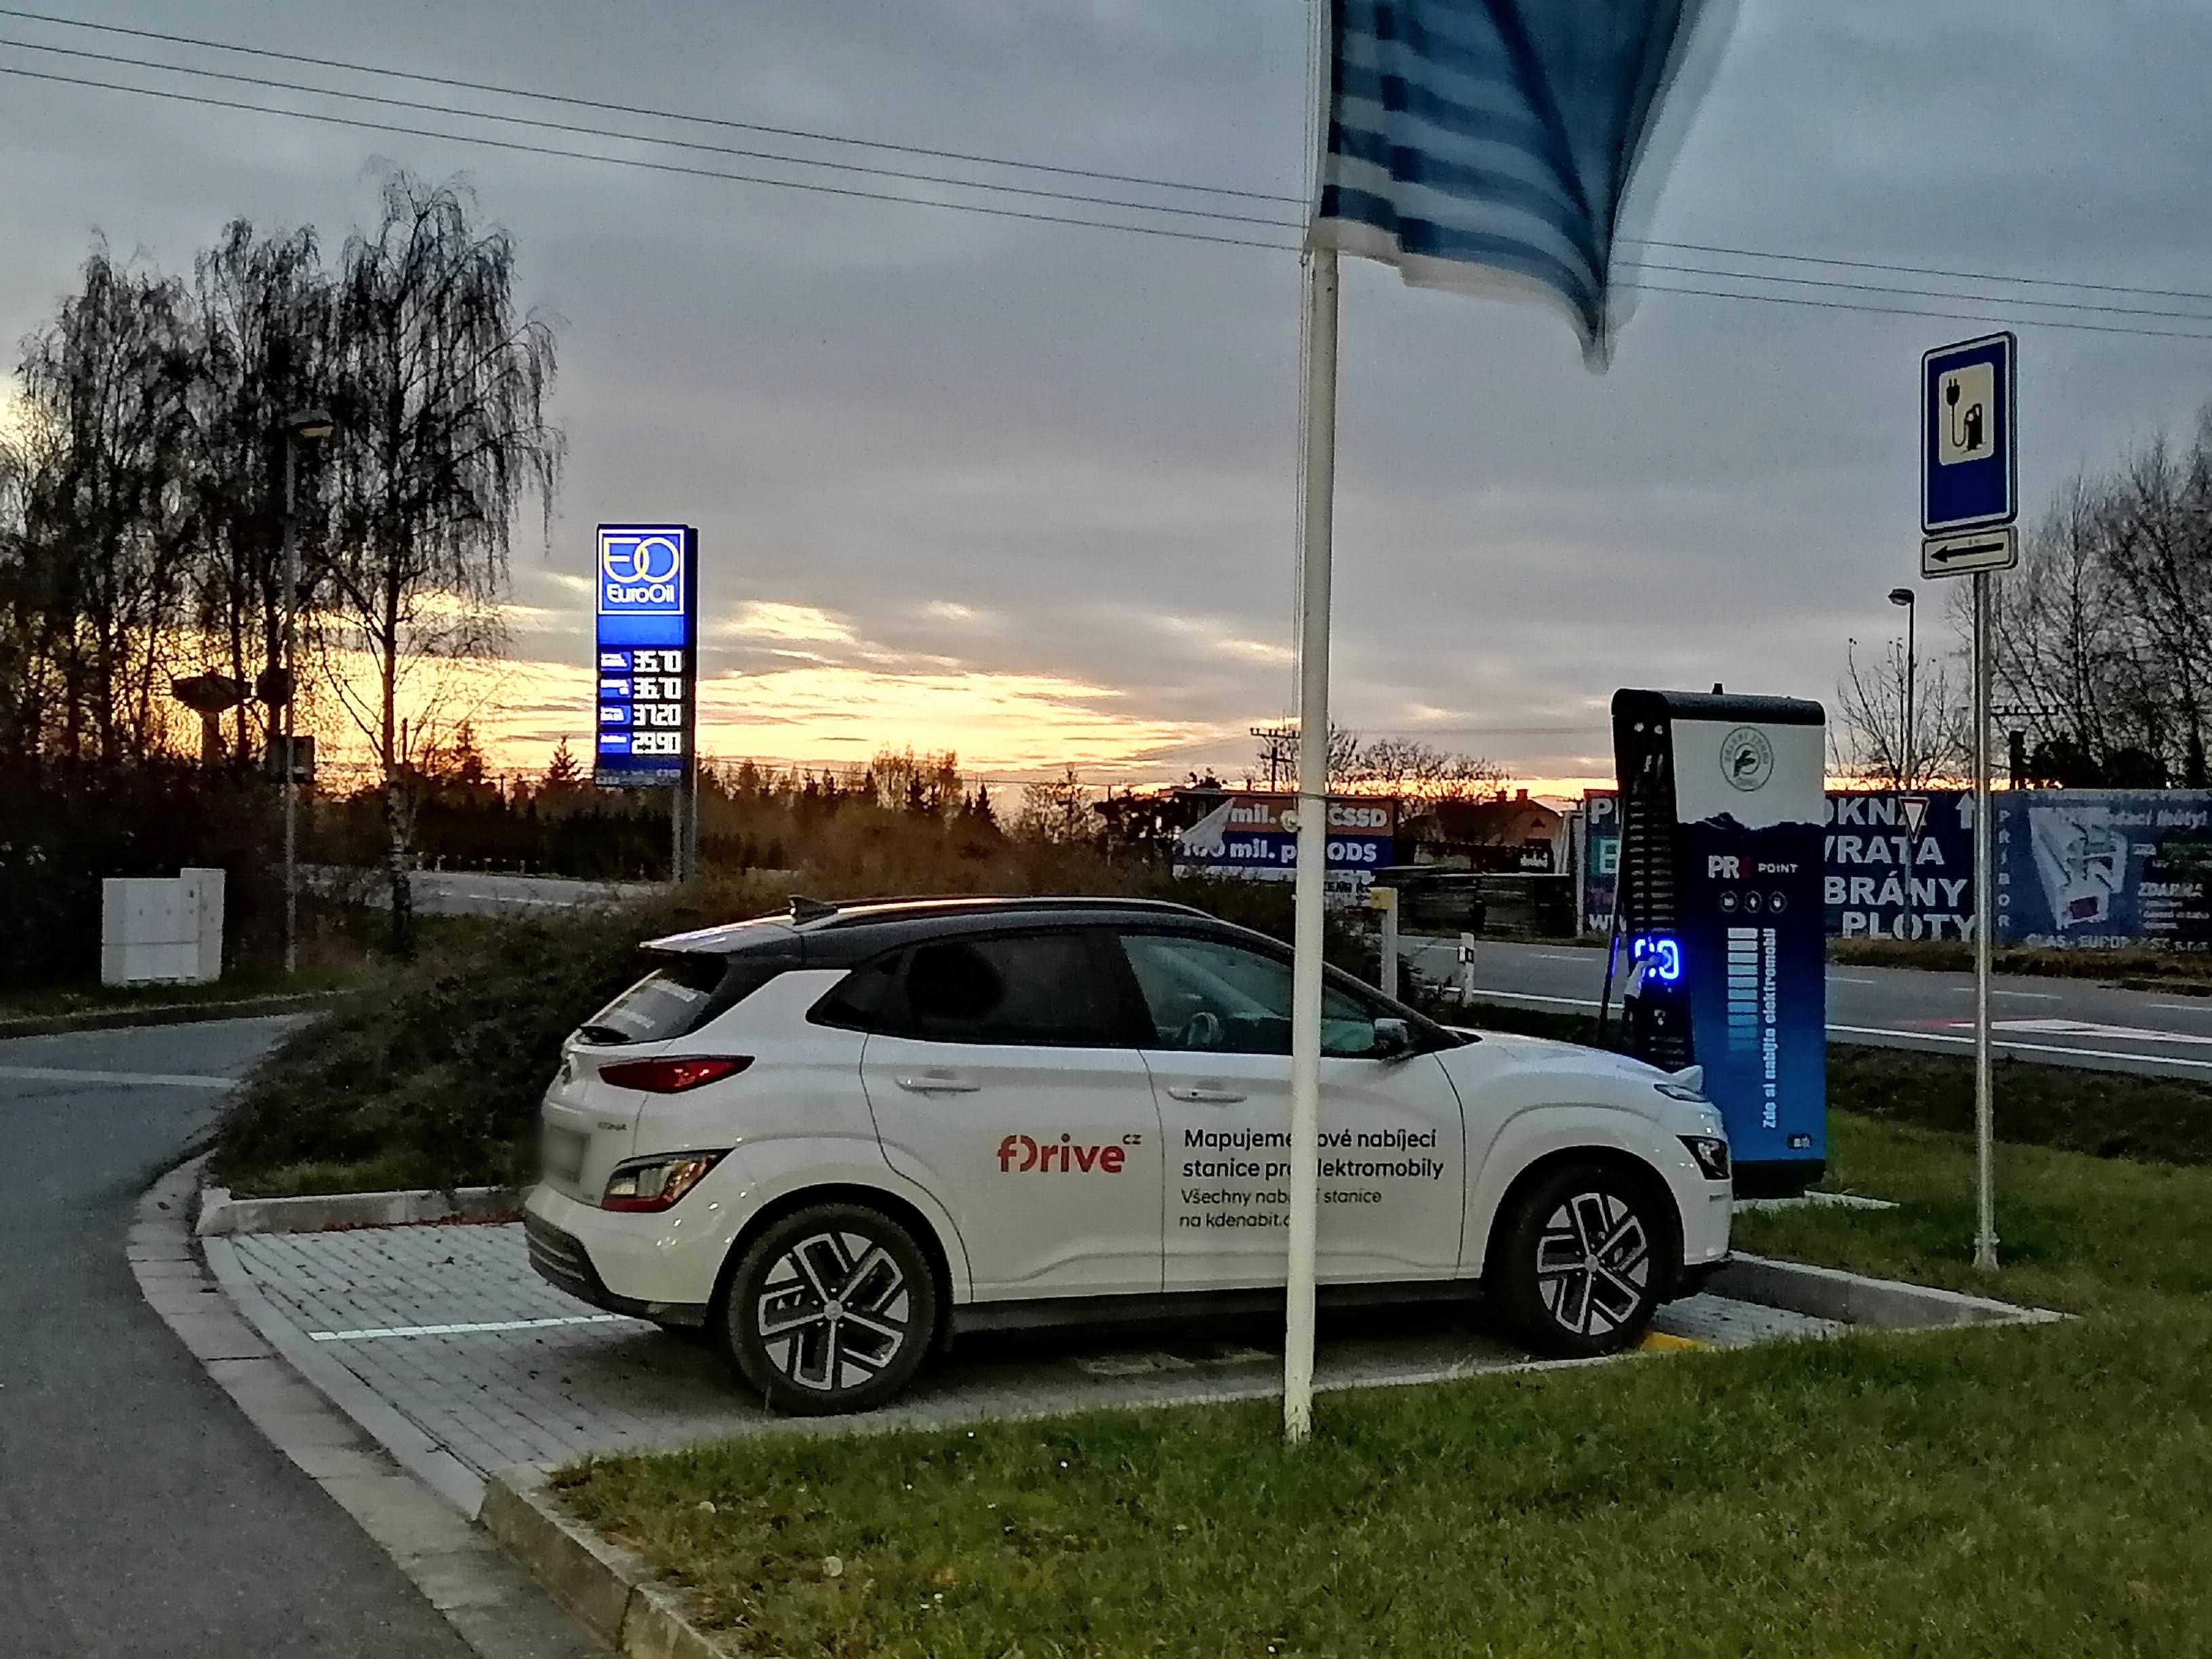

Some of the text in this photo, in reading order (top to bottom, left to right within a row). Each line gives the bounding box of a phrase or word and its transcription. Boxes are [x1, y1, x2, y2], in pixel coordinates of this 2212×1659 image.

[607, 583, 675, 603] EuroOil
[1231, 804, 1277, 823] mil.
[1230, 838, 1275, 858] mil.
[1327, 842, 1376, 862] ODS
[1708, 855, 1799, 878] PR POINT
[1824, 871, 1967, 907] BRÁNY
[1843, 912, 1976, 942] PLOTY
[1317, 1128, 1353, 1147] ové
[1357, 1128, 1436, 1151] nabíjecí
[1183, 1158, 1260, 1177] stanice
[1317, 1158, 1444, 1180] lektromobily
[1181, 1188, 1250, 1206] Všechny
[1323, 1191, 1382, 1204] stanice
[1179, 1214, 1290, 1228] na kdenabit.c
